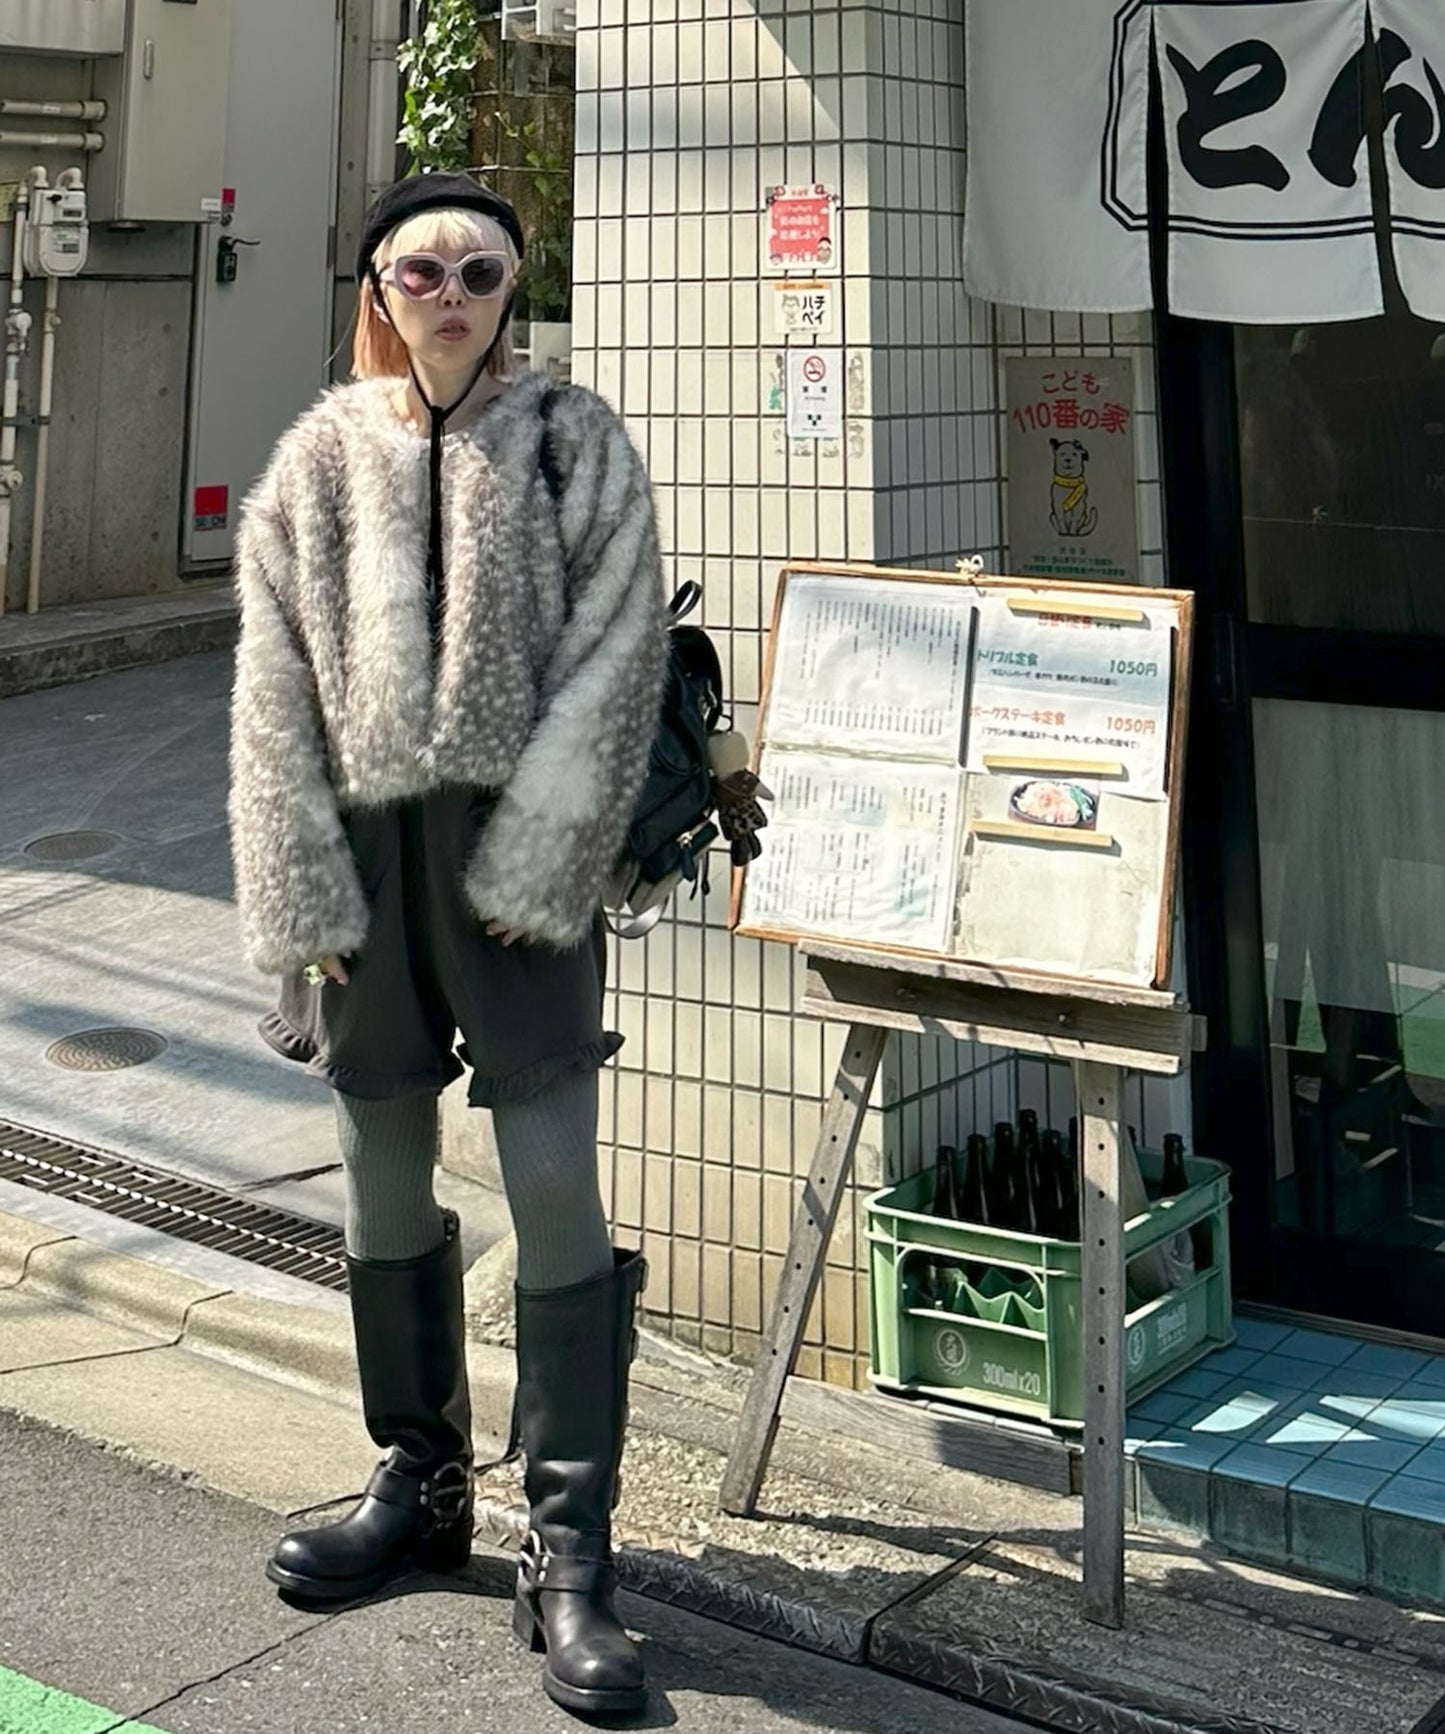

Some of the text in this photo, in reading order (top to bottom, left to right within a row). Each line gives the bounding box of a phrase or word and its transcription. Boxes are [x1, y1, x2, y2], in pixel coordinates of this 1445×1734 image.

[1166, 27, 1445, 191] とん
[1041, 370, 1101, 394] こども
[1013, 398, 1130, 435] 110番の家
[1109, 659, 1157, 677] 1050円
[1106, 715, 1156, 735] 1050円
